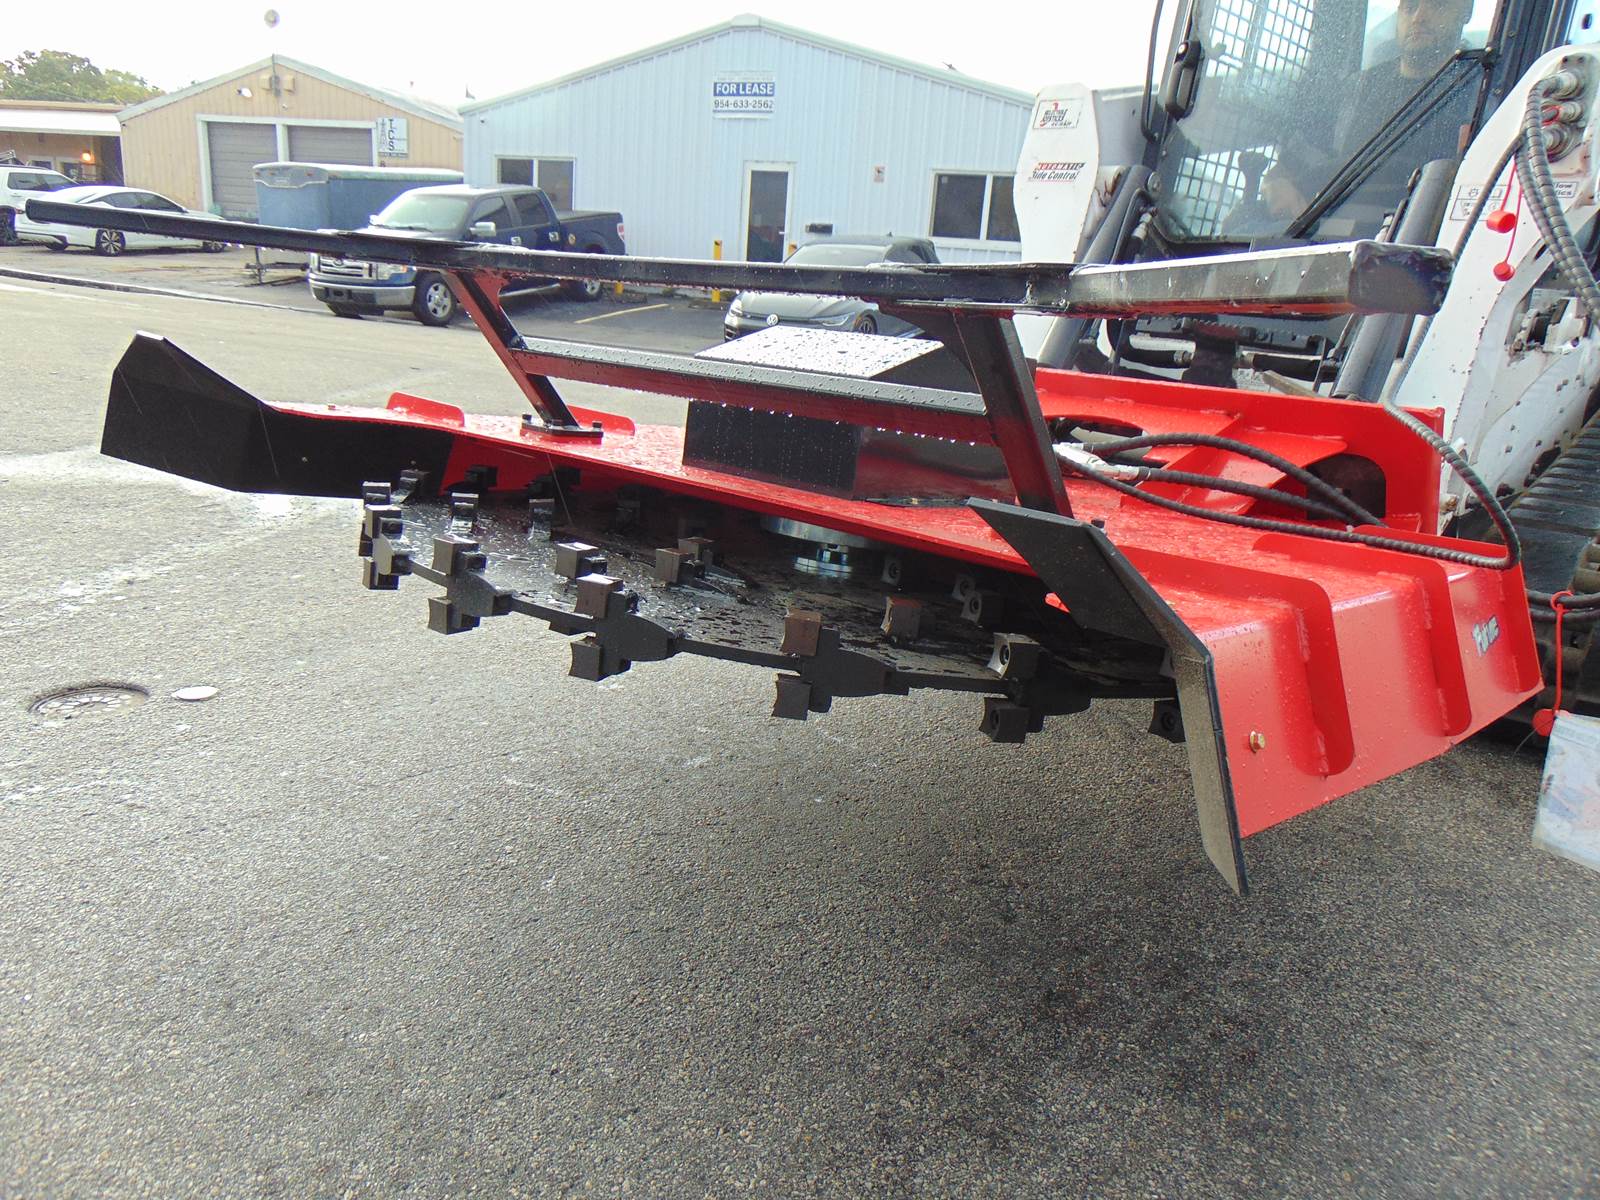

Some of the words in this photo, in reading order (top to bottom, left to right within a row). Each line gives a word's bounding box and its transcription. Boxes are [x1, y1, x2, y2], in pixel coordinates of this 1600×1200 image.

[716, 83, 737, 95] FOR
[739, 83, 774, 95] LEASE
[714, 99, 774, 109] 954-633-2562
[1048, 171, 1079, 180] Control
